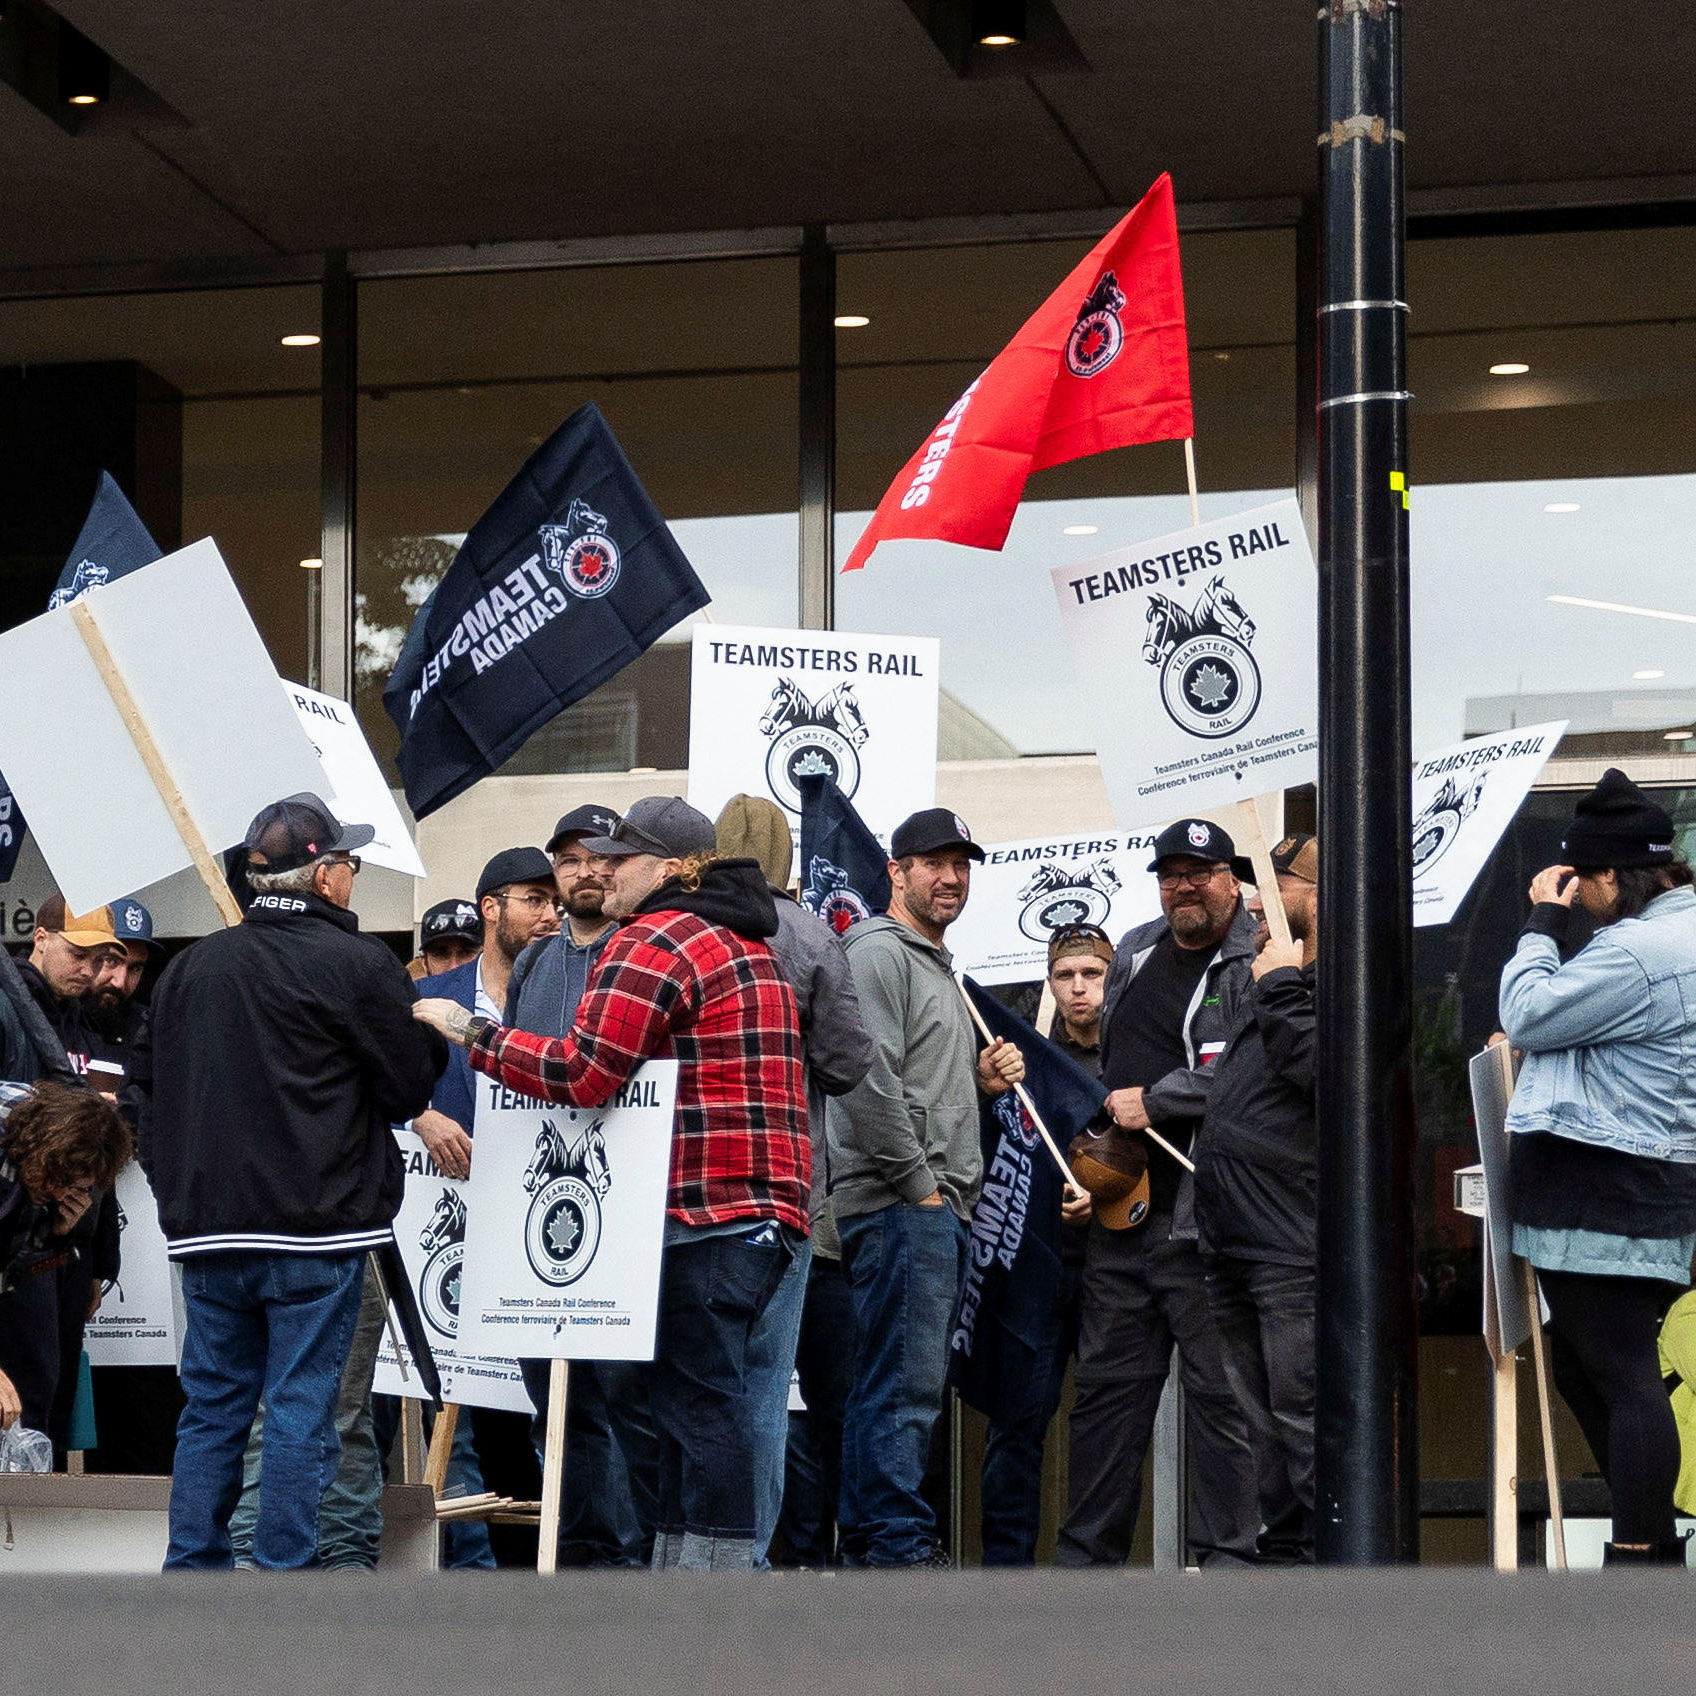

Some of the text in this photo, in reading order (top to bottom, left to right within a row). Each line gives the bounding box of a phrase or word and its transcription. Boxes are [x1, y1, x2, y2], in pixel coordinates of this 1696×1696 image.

[1070, 522, 1290, 605] TEAMSTERS RAIL
[710, 642, 923, 676] TEAMSTERS RAIL
[1173, 641, 1235, 672] TEAMSTERS
[293, 694, 346, 725] RAIL
[1209, 717, 1232, 730] RAIL
[783, 731, 844, 753] TEAMSTERS
[1154, 727, 1305, 775] Teamsters Canada Rail Conference
[1418, 736, 1545, 781] TEAMSTERS RAIL
[1138, 776, 1187, 796] Conférence
[1189, 763, 1236, 783] ferroviaire
[1238, 759, 1249, 770] de
[1251, 747, 1296, 765] Teamsters
[980, 835, 1156, 866] TEAMSTERS RA
[253, 895, 306, 912] FIGER
[618, 1081, 660, 1108] RAIL
[541, 1184, 590, 1207] TEAMSTERS
[551, 1267, 569, 1276] RAIL
[499, 1298, 616, 1309] Teamsters Canada Rail Conference
[99, 1316, 146, 1324] Conference
[481, 1314, 631, 1326] Conférence ferroviaire de Teamsters Canada
[89, 1330, 167, 1338] Teamsters Canada
